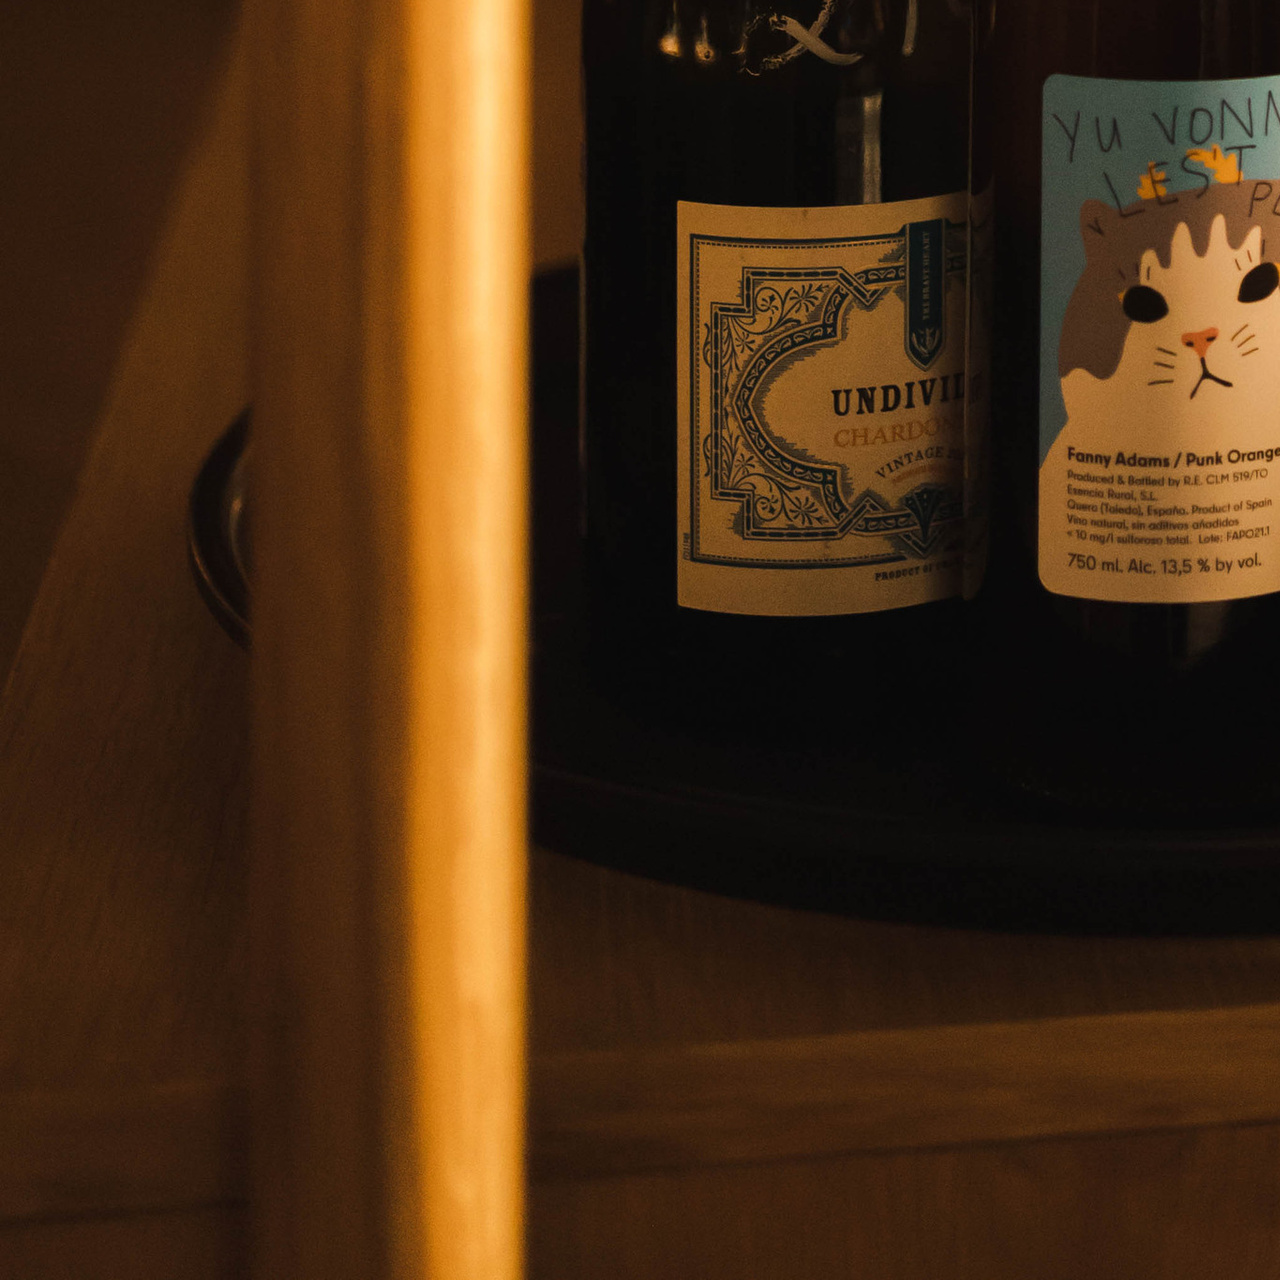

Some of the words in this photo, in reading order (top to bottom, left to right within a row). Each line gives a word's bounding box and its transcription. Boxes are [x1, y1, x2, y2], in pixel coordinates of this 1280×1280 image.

[1052, 110, 1122, 163] YU
[875, 445, 945, 479] VINTAGE
[1067, 446, 1111, 469] Fanny
[1115, 451, 1170, 468] Adams
[1173, 452, 1182, 469] /
[1186, 451, 1223, 467] Punk
[1067, 469, 1114, 484] Produced
[1117, 475, 1125, 485] &
[1128, 474, 1165, 486] Bottled
[1168, 476, 1180, 488] by
[1206, 473, 1229, 485] CLM
[1067, 484, 1104, 498] Esencia
[1107, 488, 1137, 501] Rural,
[1191, 503, 1231, 515] Product
[1233, 500, 1243, 512] of
[1246, 497, 1273, 511] Spain
[1066, 513, 1088, 525] Vino
[1131, 521, 1146, 530] sin
[1148, 520, 1189, 531] aditivos
[1192, 517, 1240, 530] añadidos
[1075, 529, 1087, 540] 10
[1198, 534, 1223, 544] Lote:
[1067, 552, 1097, 571] 750
[1101, 557, 1123, 573] ml.
[1128, 558, 1156, 574] Alc.
[1161, 559, 1192, 576] 13,5
[1197, 558, 1211, 573] %
[1215, 557, 1233, 574] by
[1237, 552, 1262, 569] vol.
[874, 566, 920, 581] PRODUCT
